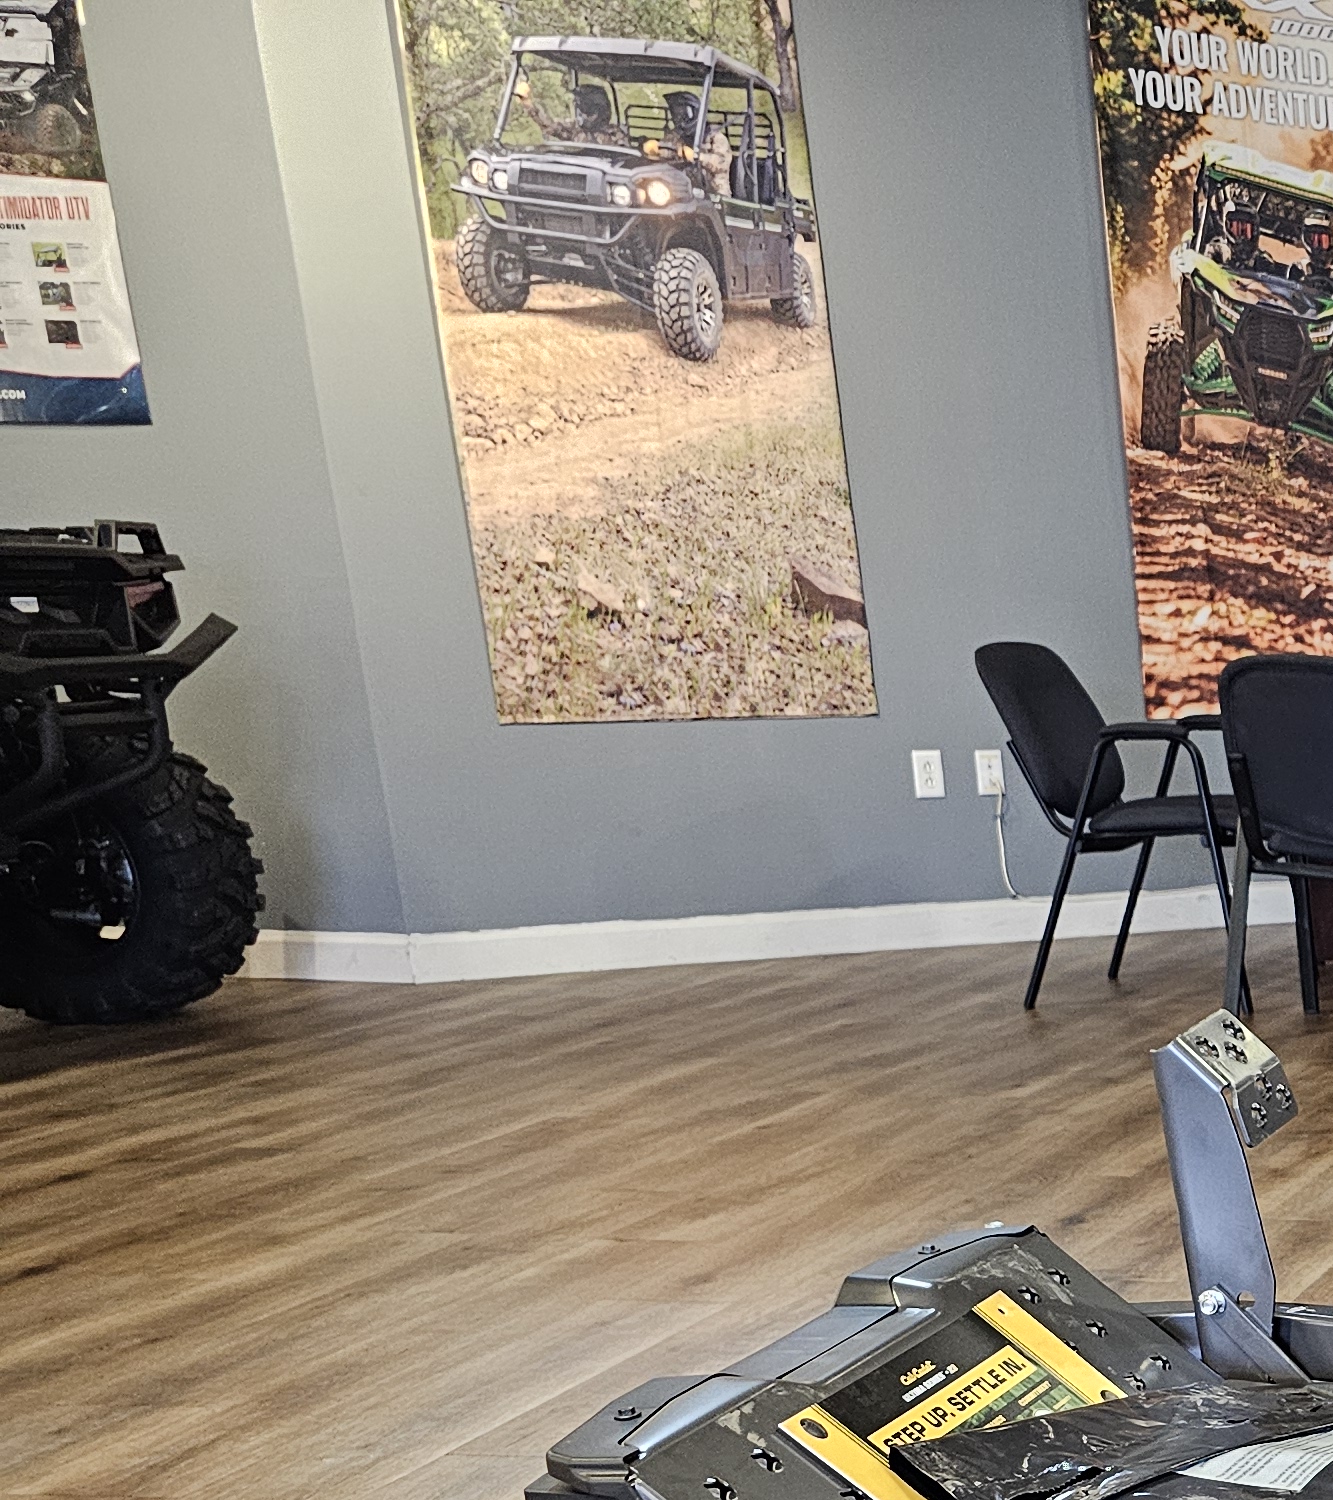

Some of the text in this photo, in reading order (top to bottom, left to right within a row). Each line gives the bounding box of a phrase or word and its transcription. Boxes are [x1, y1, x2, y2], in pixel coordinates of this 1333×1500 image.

[1155, 26, 1228, 72] YOUR
[1128, 68, 1203, 115] YOUR
[65, 196, 90, 219] UTV
[946, 1368, 1002, 1412] SETTLE
[998, 1357, 1027, 1377] IN.
